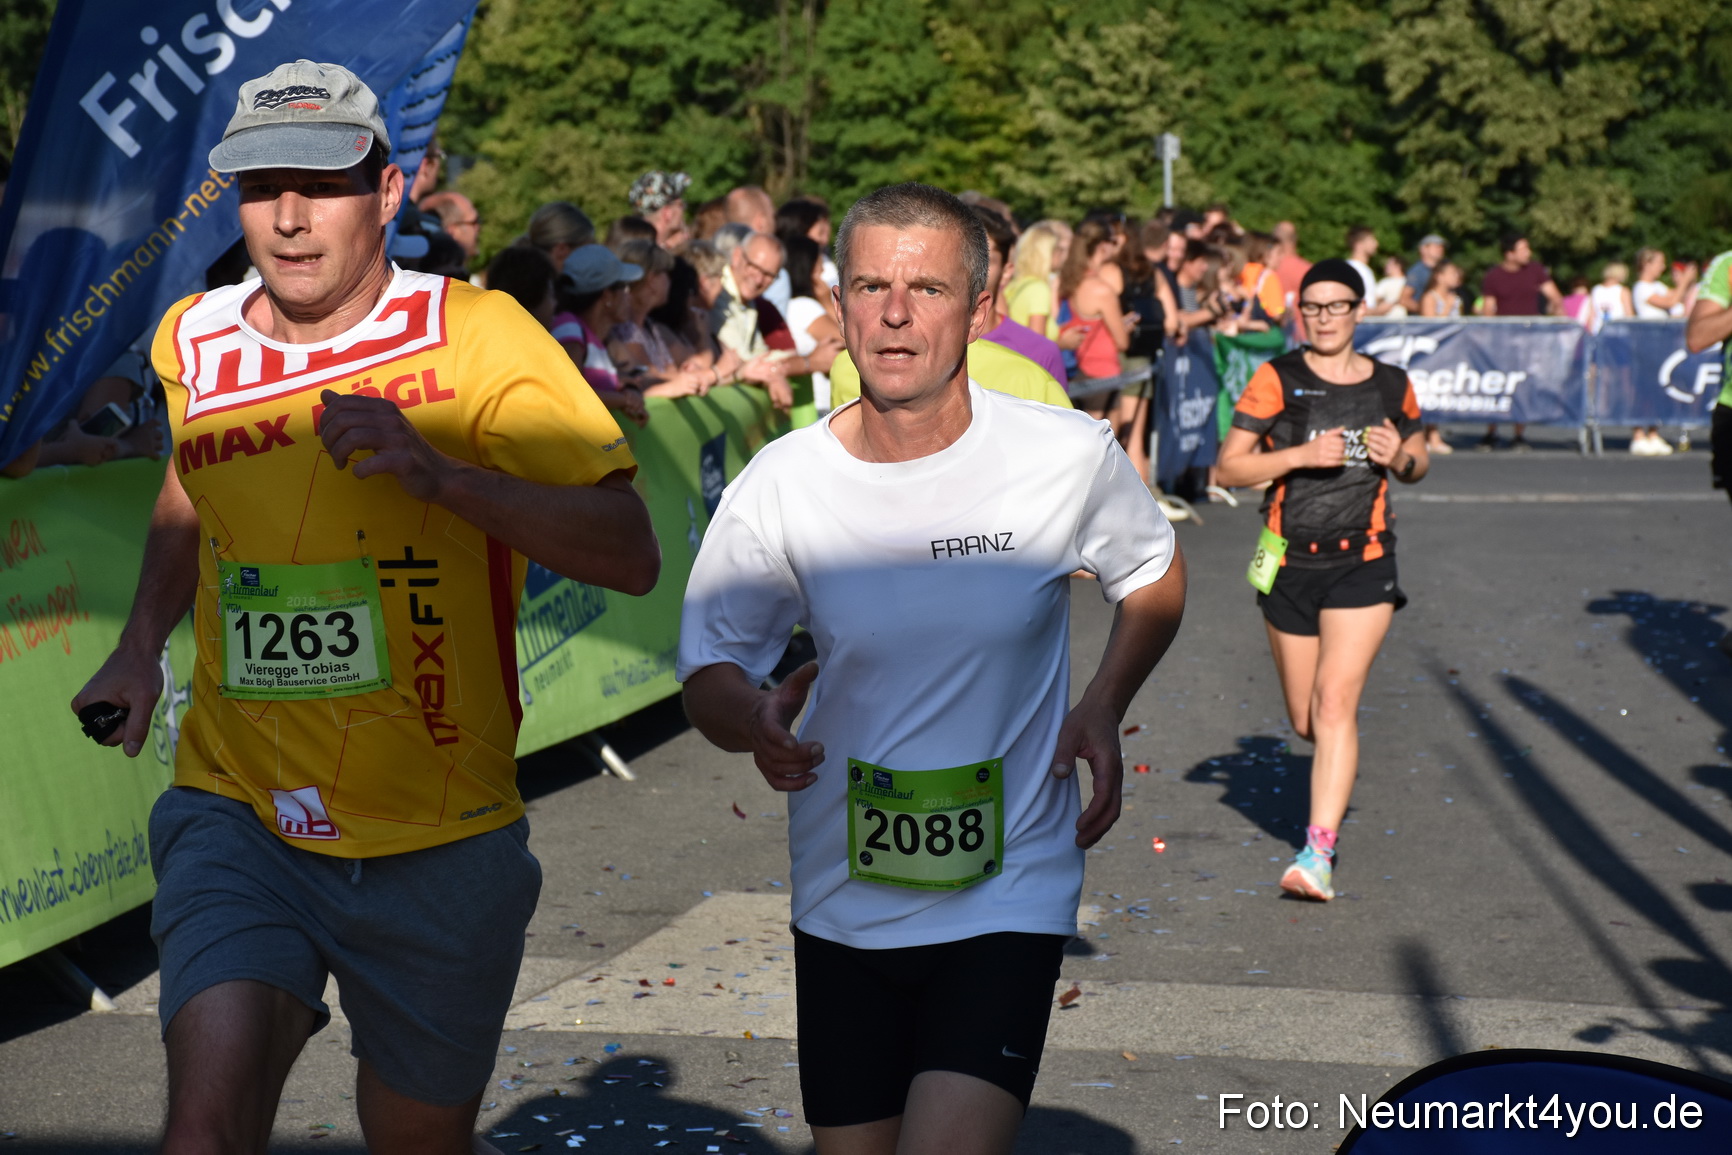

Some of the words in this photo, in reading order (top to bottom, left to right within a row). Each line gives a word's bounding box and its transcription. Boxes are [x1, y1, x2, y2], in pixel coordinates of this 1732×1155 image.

[79, 0, 293, 159] Frisc
[0, 168, 236, 422] w.frischmann-net.
[1406, 361, 1527, 396] scher
[1417, 394, 1513, 413] OMOBILE
[179, 414, 297, 475] MAX
[930, 532, 1015, 560] FRANZ
[233, 583, 279, 598] firmenlauf
[286, 596, 317, 608] 2018
[235, 611, 359, 661] 1263
[239, 676, 254, 686] Max
[256, 676, 275, 688] Bögl
[277, 677, 328, 687] Bauservice
[330, 672, 361, 683] GmbH
[245, 662, 299, 679] Vieregge
[302, 661, 350, 675] Tobias
[864, 781, 915, 801] firmenlauf
[922, 797, 953, 809] 2018
[864, 808, 985, 857] 2088
[0, 819, 149, 924] rmenlauf-oberpfalz.de
